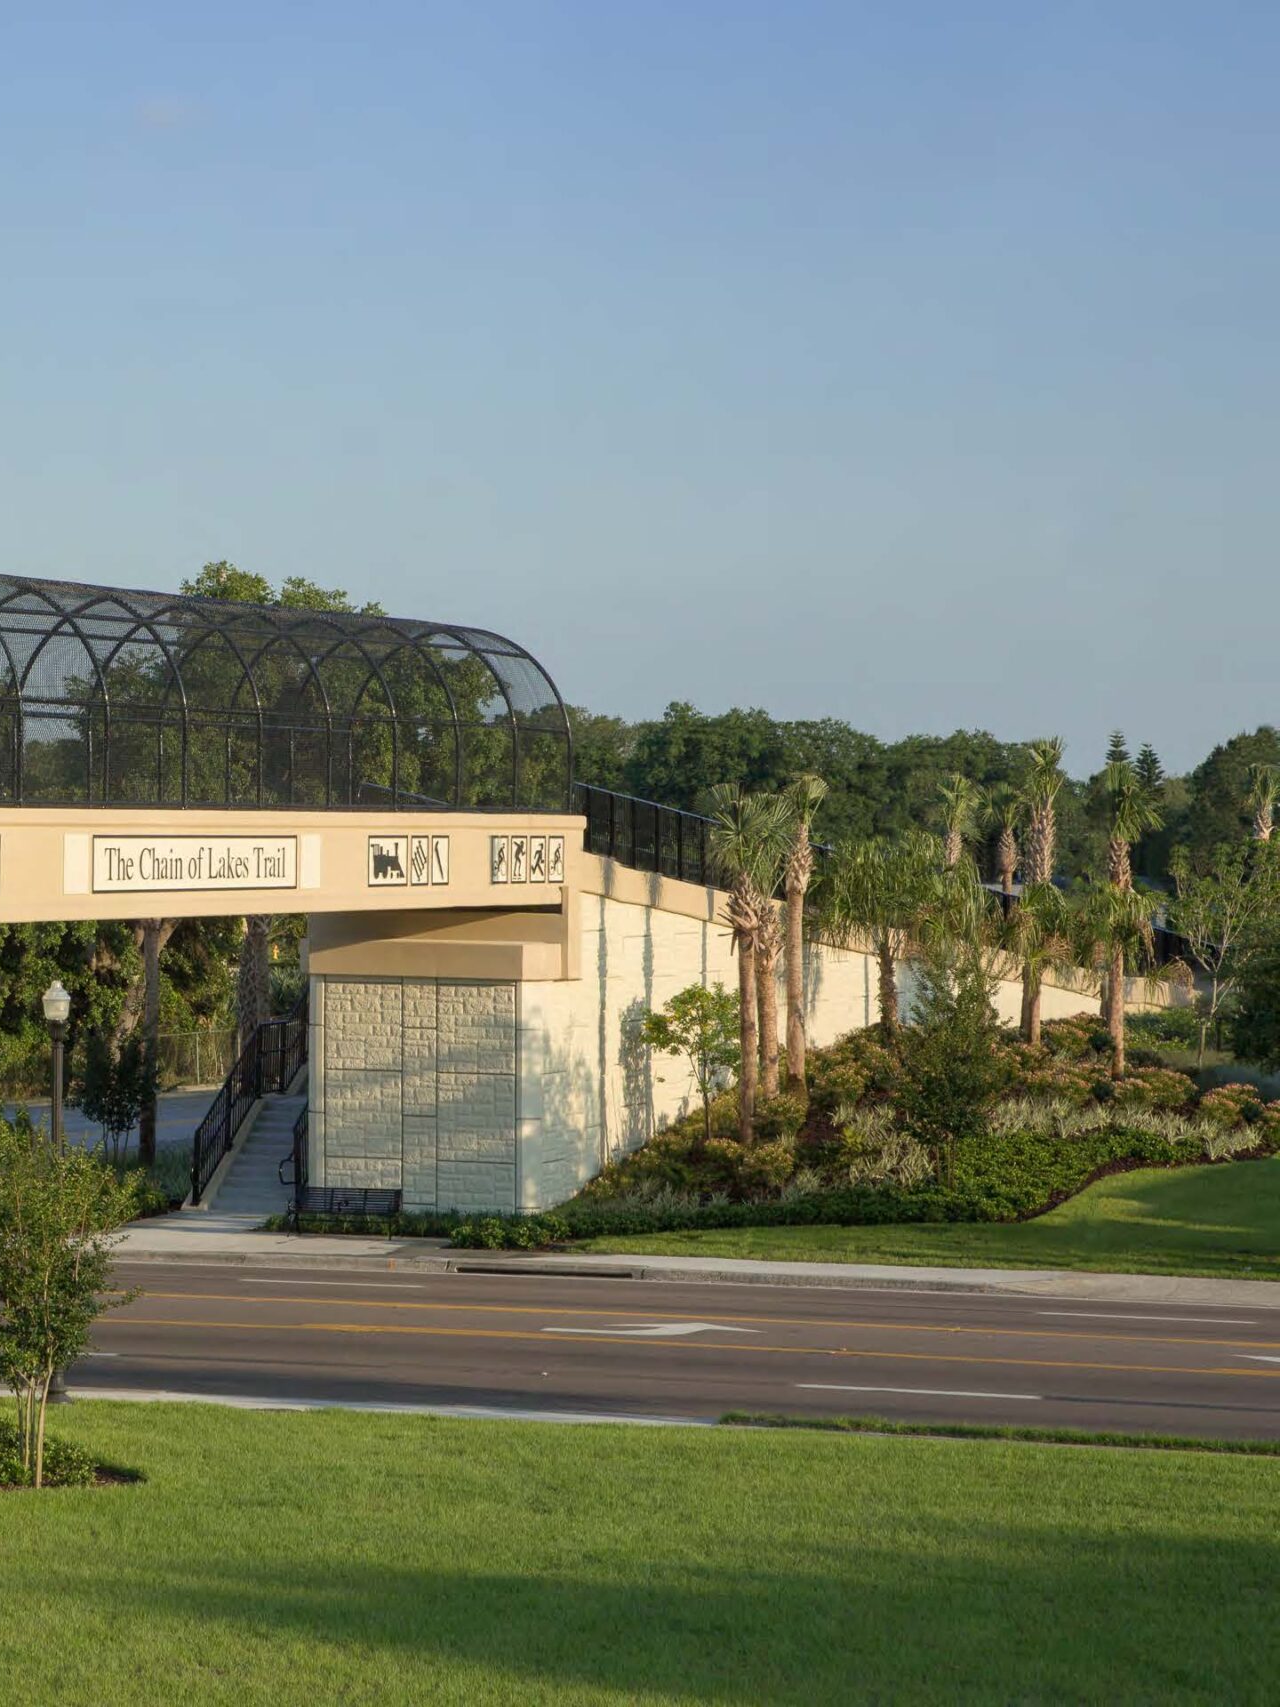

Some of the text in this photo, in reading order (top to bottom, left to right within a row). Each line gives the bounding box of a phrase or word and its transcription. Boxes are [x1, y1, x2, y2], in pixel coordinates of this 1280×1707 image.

[104, 847, 286, 881] The Chain of Lakes Trail
